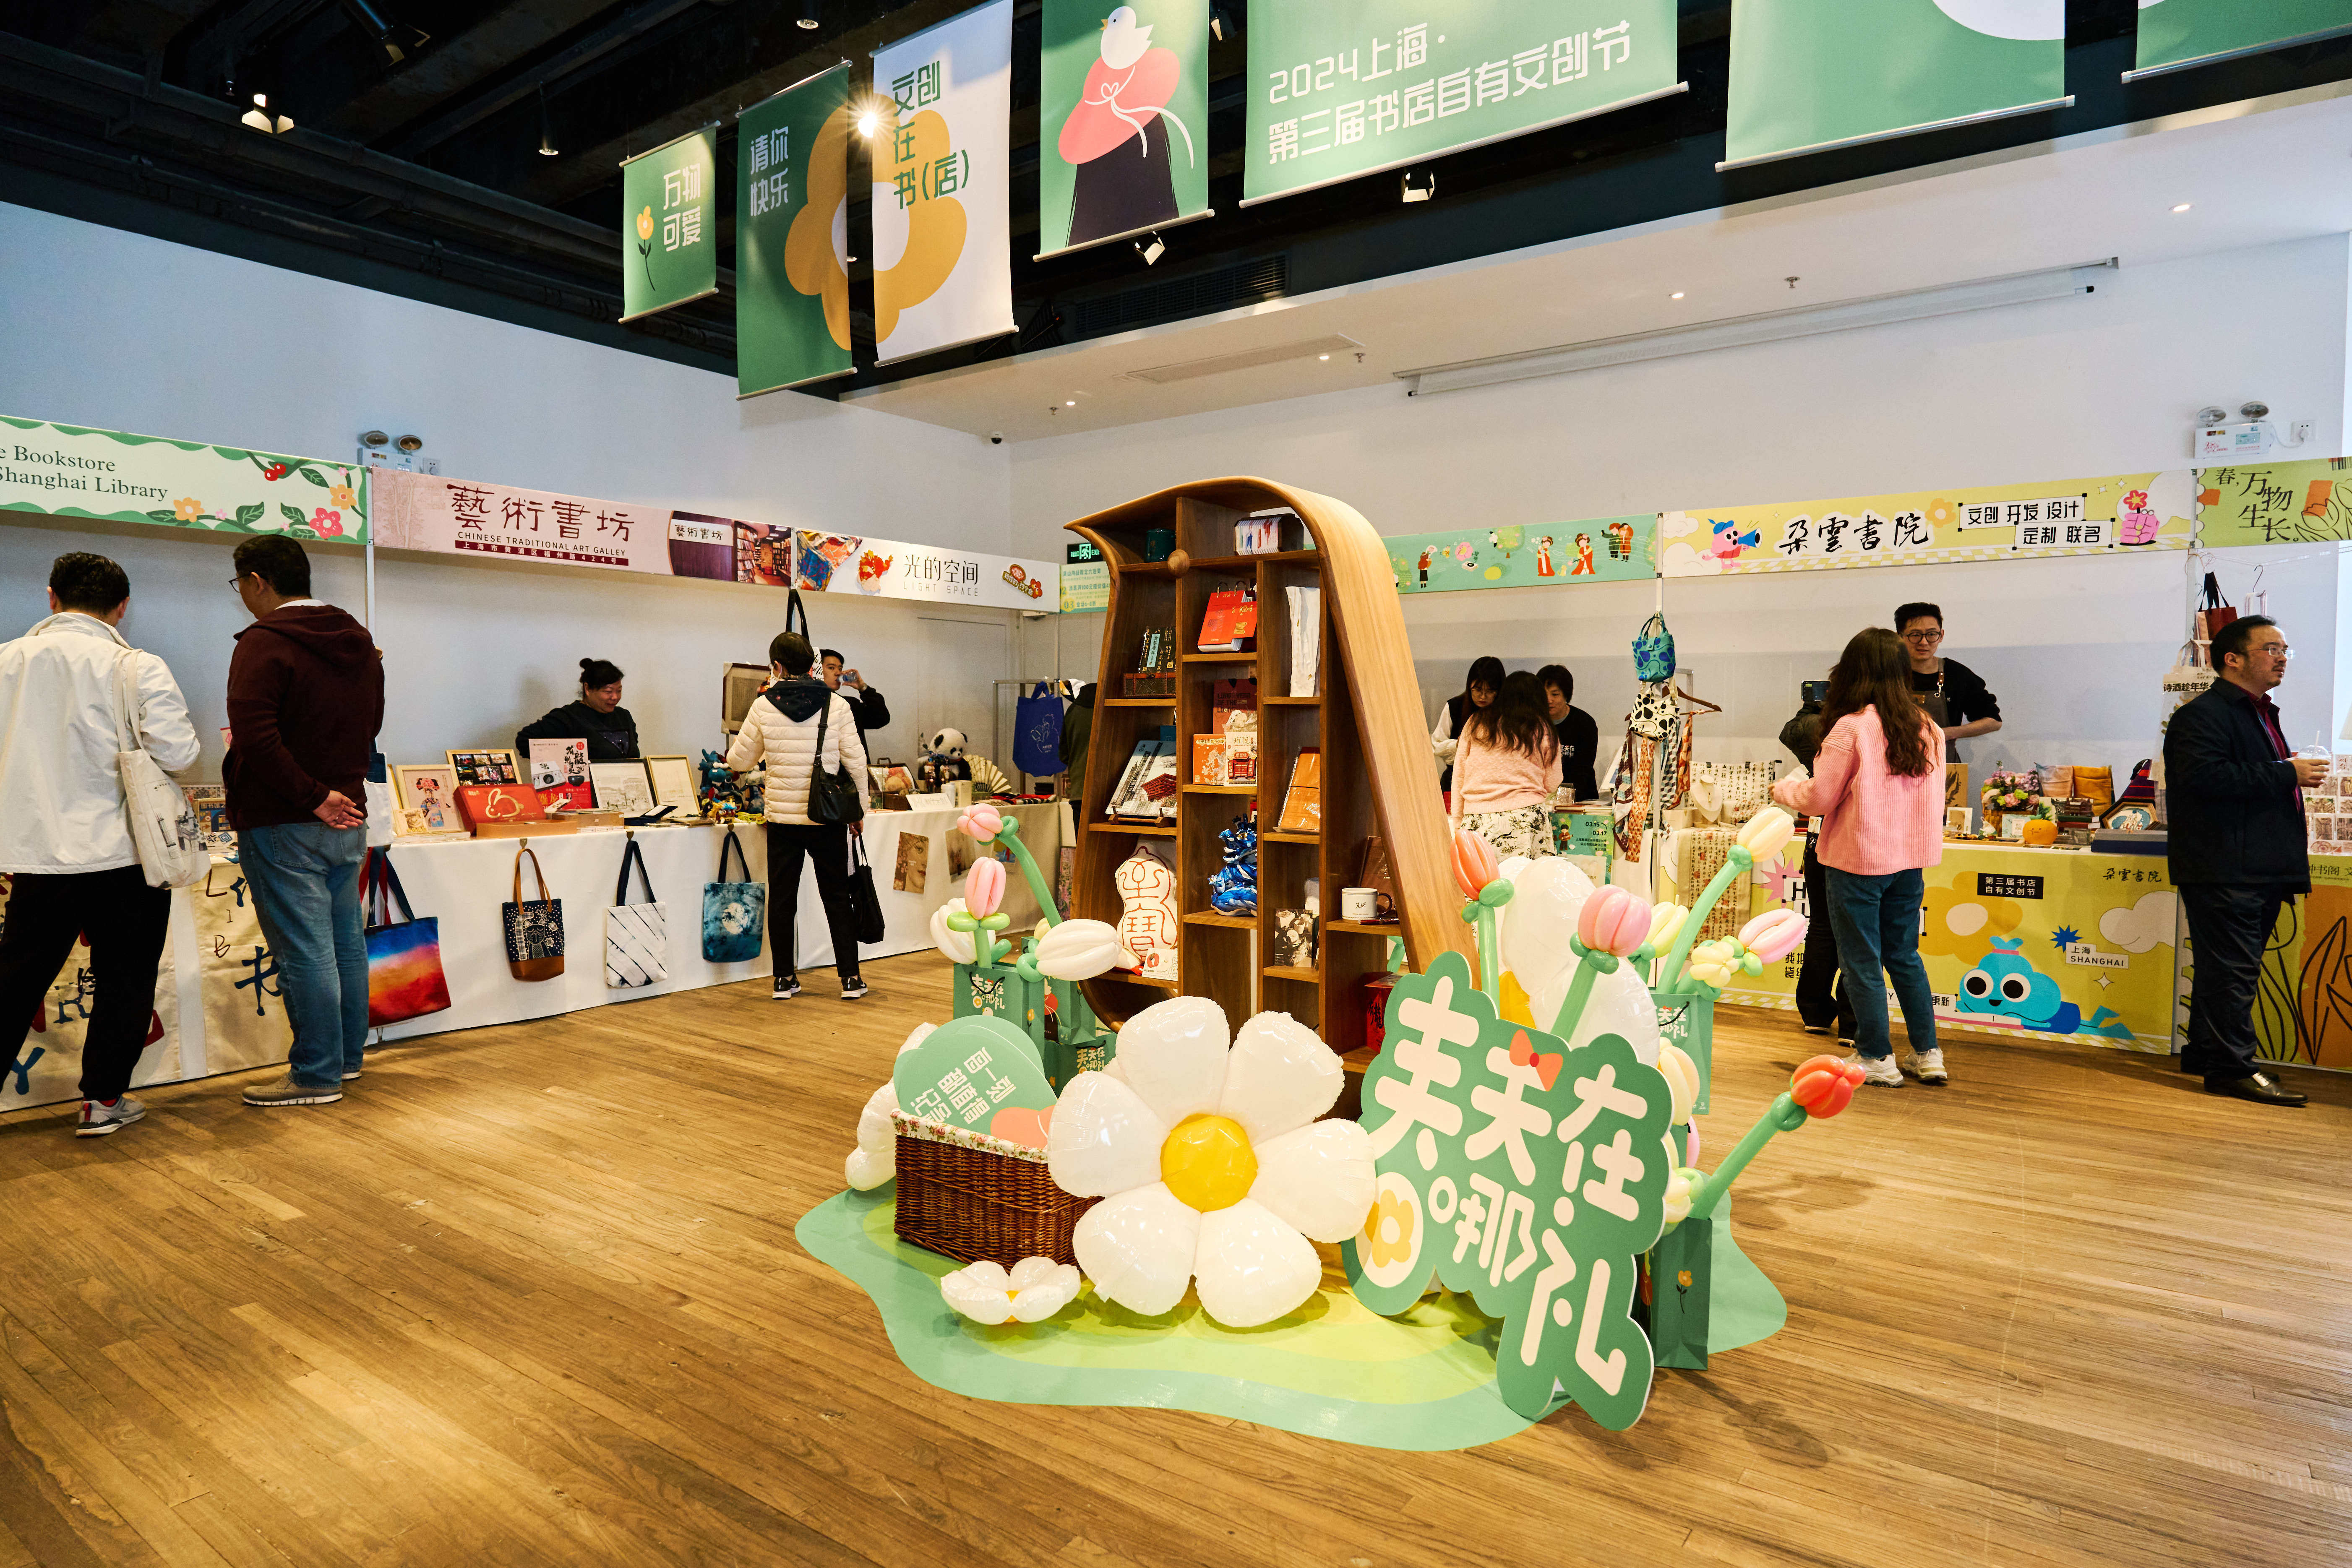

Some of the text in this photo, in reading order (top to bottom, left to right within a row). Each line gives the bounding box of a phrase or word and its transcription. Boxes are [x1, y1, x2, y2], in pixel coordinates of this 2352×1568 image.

[892, 60, 941, 116] 文创
[1269, 20, 1630, 165] 第三届书店自有文创节
[750, 125, 789, 175] 请你
[893, 122, 915, 164] 在
[663, 162, 701, 211] 万物
[750, 168, 789, 216] 快乐
[663, 206, 701, 252] 可爱
[14, 445, 115, 471] Bookstore
[95, 477, 168, 502] Library
[446, 484, 635, 542] 藝術書坊
[1968, 500, 2079, 525] 文创 开发 设计
[458, 531, 501, 543] CHINESE
[506, 537, 569, 550] TRADITIONAL
[594, 547, 625, 556] GALLEY
[675, 524, 723, 540] 藝術書坊
[2023, 526, 2100, 544] 定制 联名
[463, 542, 617, 564] 上海市黄浦区福州路424号
[904, 554, 978, 585] 光的空间
[904, 581, 978, 596] LIGHT SPACE
[2164, 682, 2209, 692] 诗酒趁年华
[1985, 876, 2036, 887] 第三届书店
[1985, 886, 2036, 896] 自有文创节
[2070, 956, 2123, 966] SHANGHAI
[2071, 946, 2091, 955] 上海
